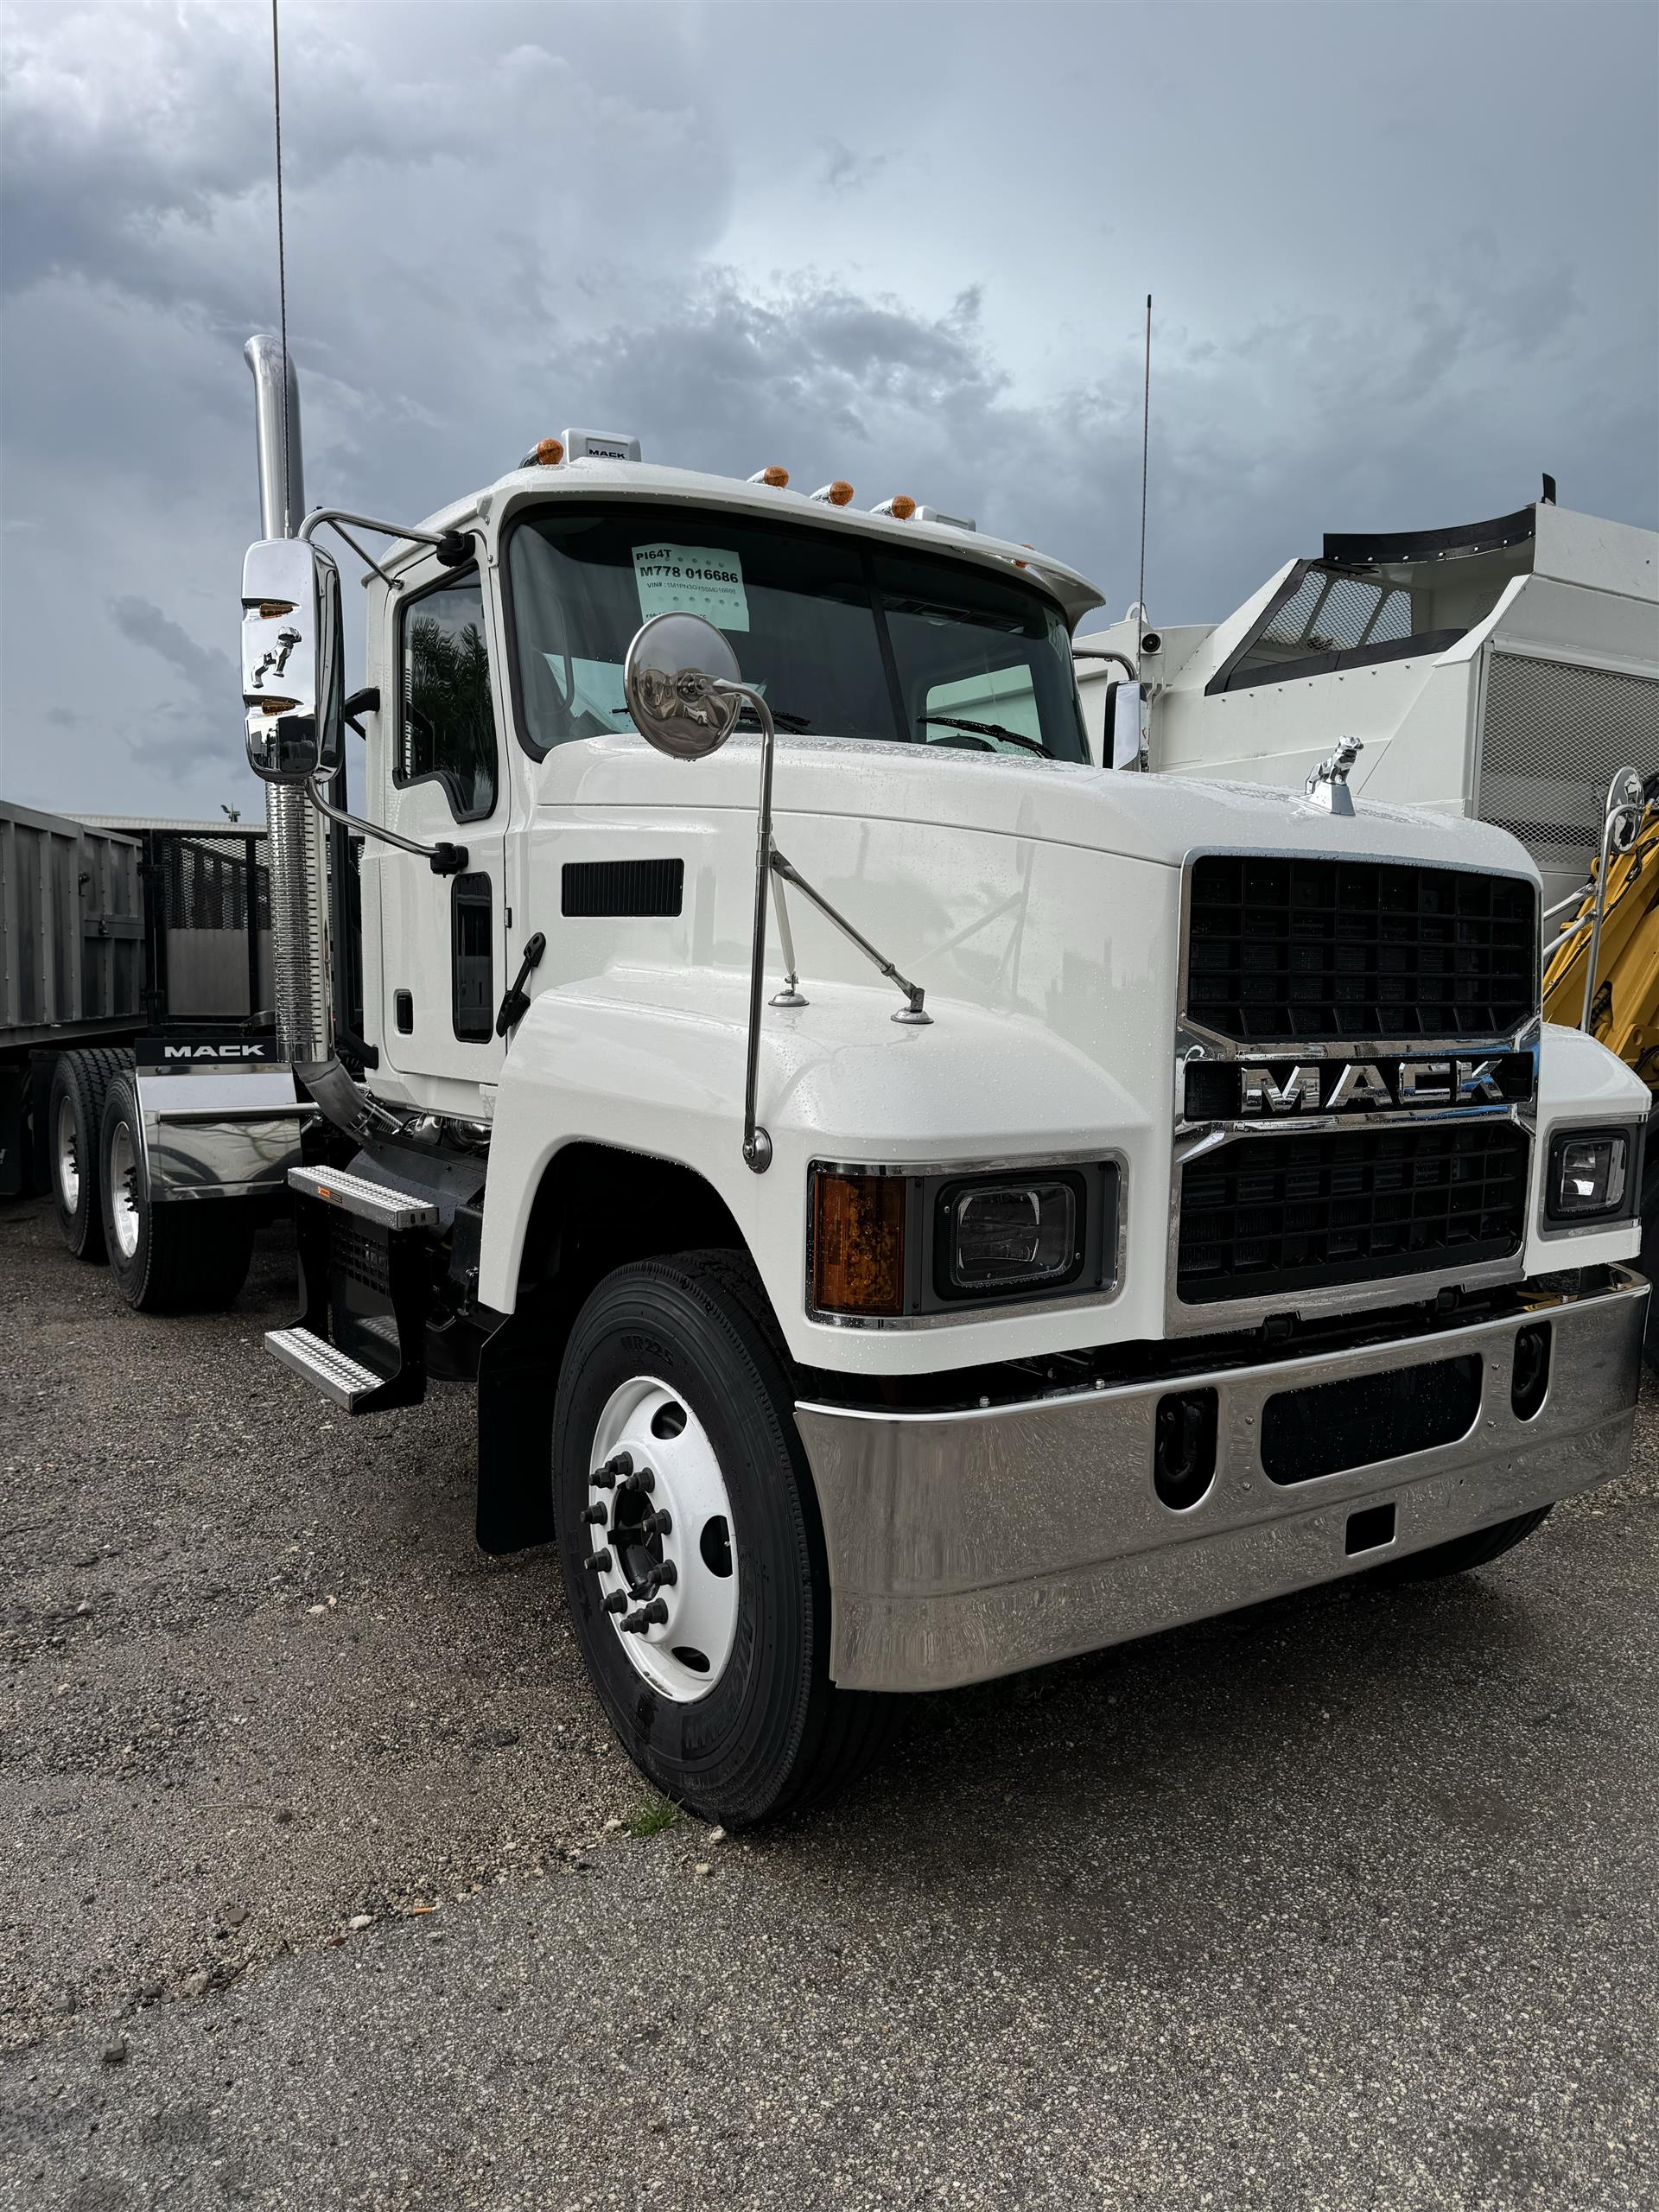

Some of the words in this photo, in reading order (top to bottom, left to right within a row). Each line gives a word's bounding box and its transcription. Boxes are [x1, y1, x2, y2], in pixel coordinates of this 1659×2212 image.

[589, 448, 625, 459] MACK
[640, 566, 681, 577] M778
[686, 568, 738, 583] 016686
[164, 1045, 264, 1058] MACK
[1240, 1059, 1503, 1114] MACK
